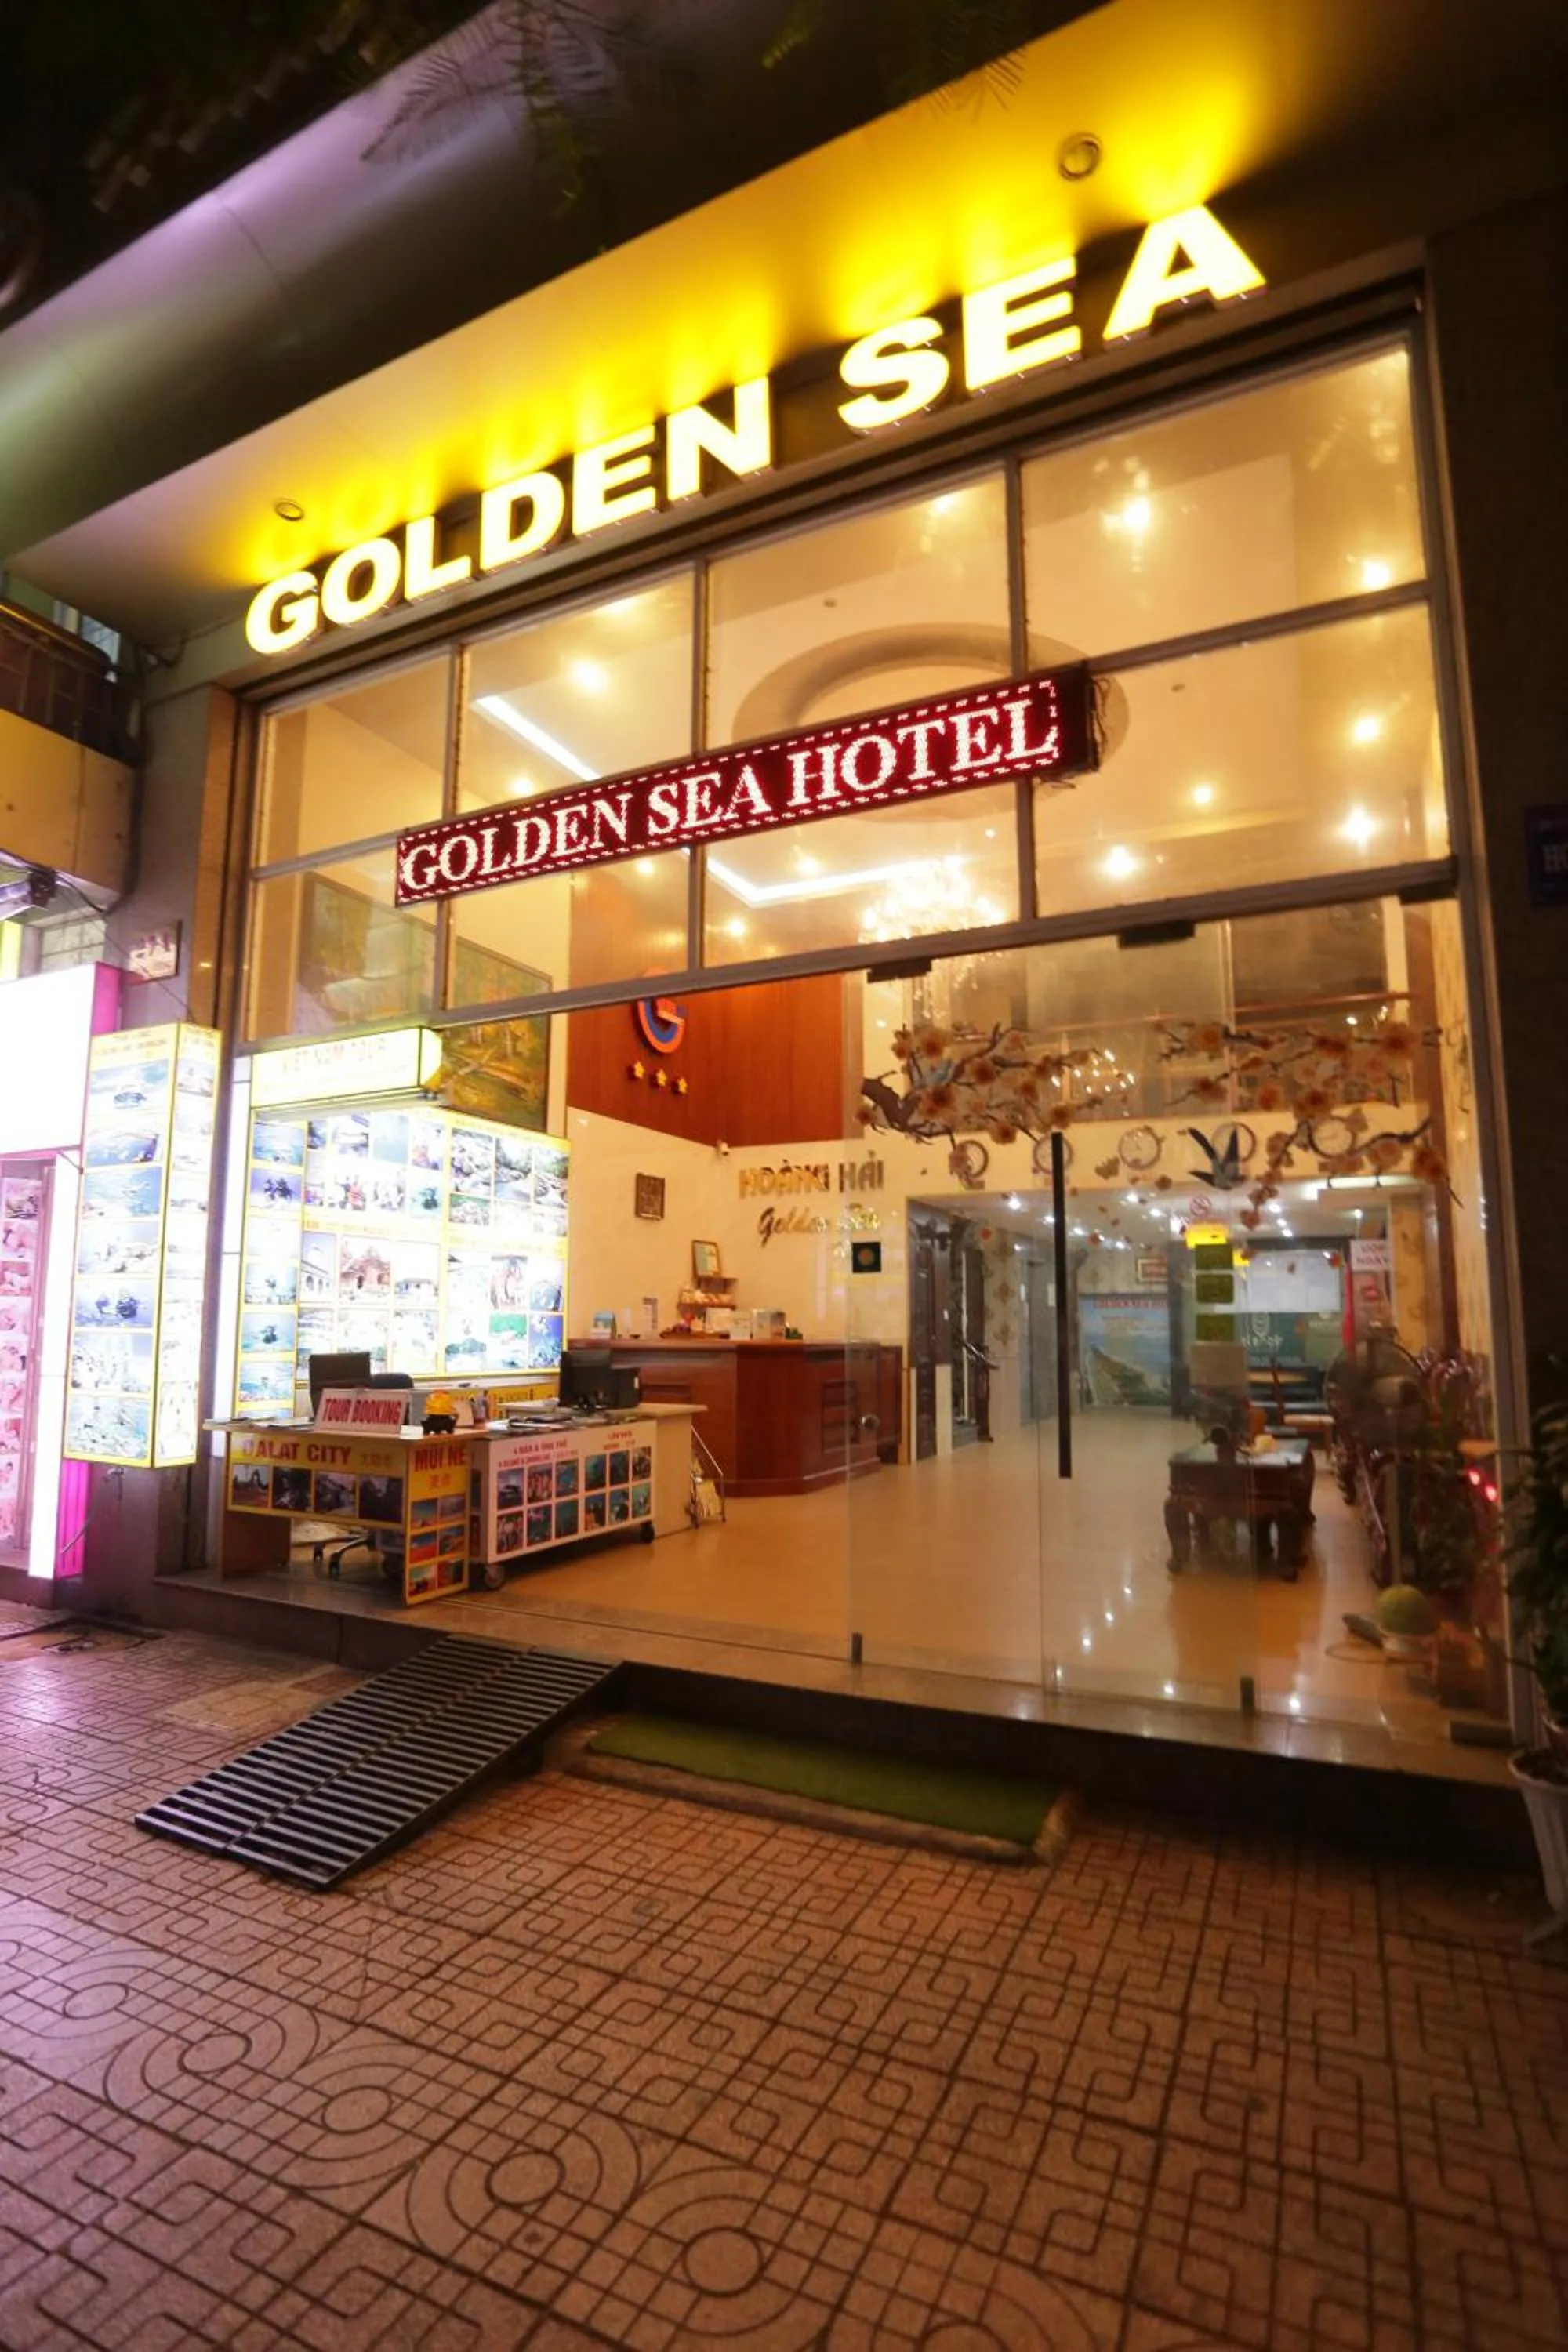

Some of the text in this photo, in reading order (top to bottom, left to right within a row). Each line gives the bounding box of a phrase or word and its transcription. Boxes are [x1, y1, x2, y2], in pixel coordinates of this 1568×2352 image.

[245, 203, 1266, 655] GOLDEN SEA
[402, 699, 1058, 891] GOLDEN SEA HOTEL
[307, 1443, 351, 1465] CITY
[322, 1398, 402, 1425] TOUR BOOKING
